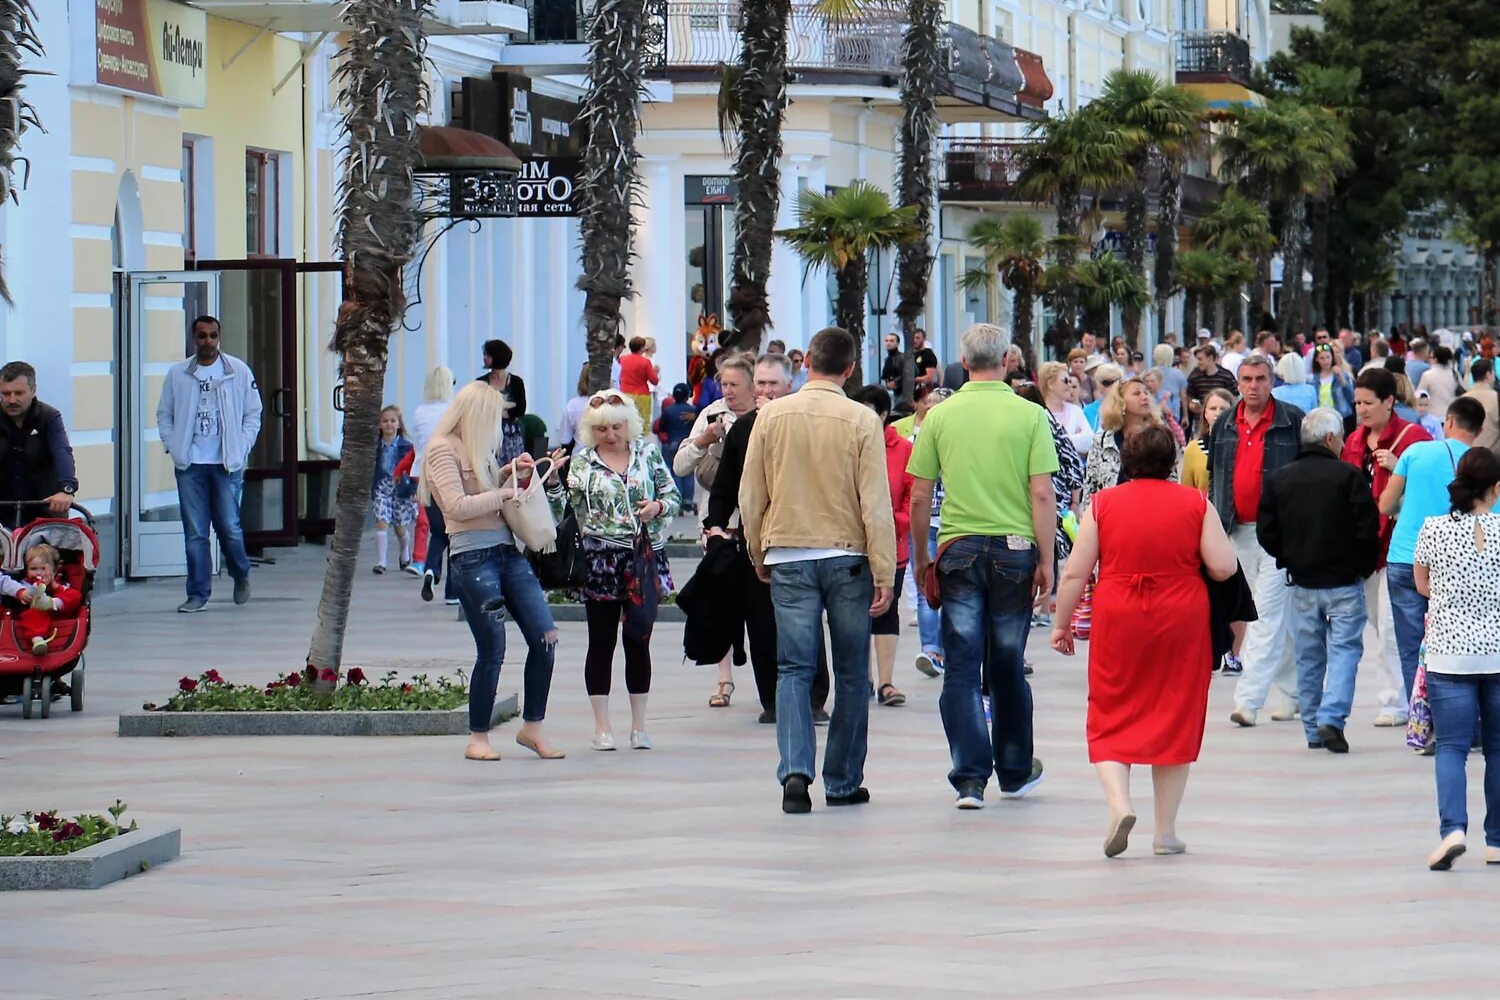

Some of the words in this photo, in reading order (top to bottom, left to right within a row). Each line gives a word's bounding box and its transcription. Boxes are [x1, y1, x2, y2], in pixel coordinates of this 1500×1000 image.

[702, 177, 730, 186] DOMINO
[706, 185, 726, 195] EIGHT
[544, 203, 572, 212] сеть
